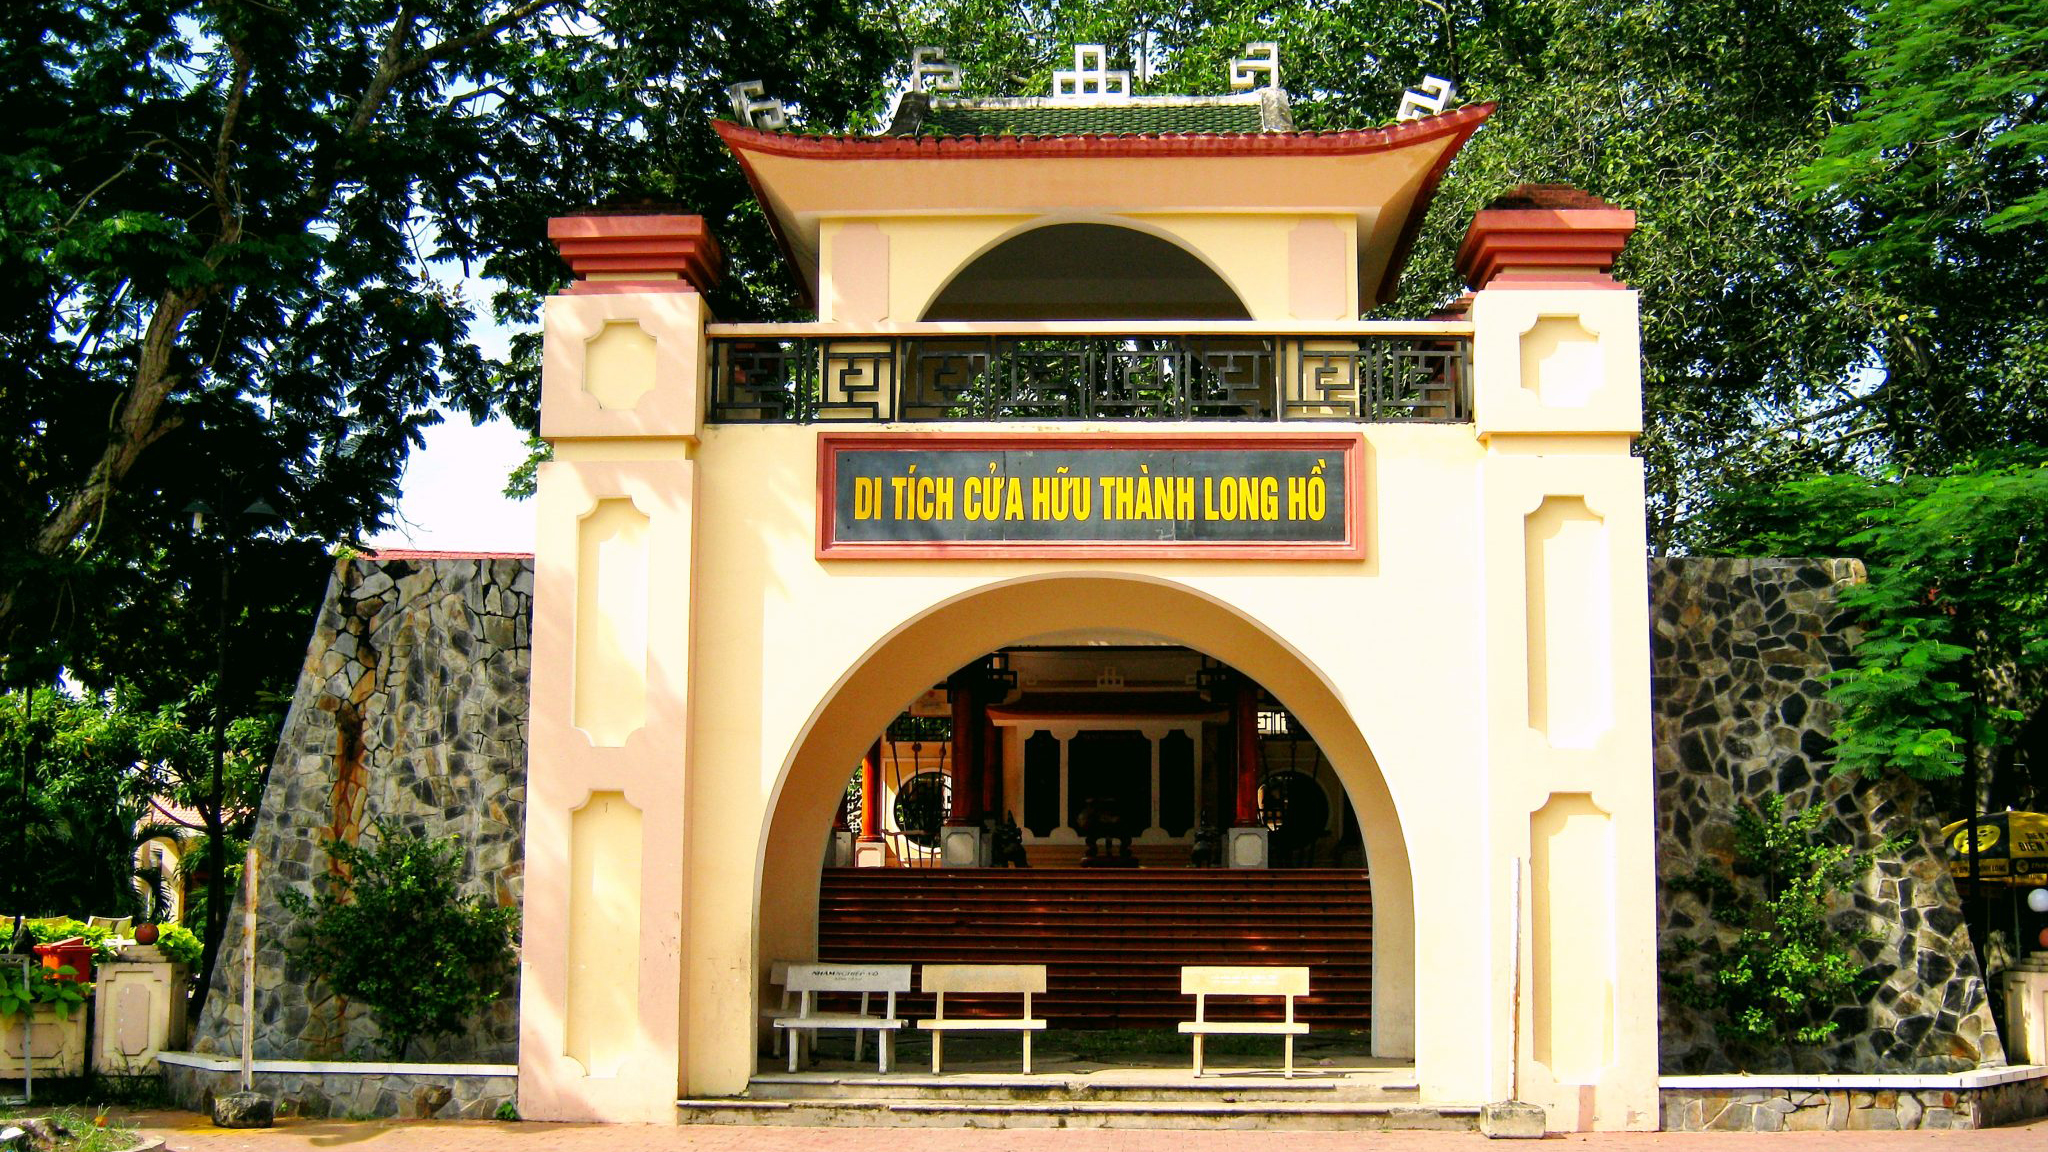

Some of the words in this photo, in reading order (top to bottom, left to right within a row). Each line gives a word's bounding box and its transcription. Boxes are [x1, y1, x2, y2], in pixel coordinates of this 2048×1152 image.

[854, 476, 883, 520] DI
[891, 464, 954, 521] TÍCH
[963, 461, 1025, 521] CỬA
[1032, 466, 1091, 521] HỮU
[1099, 464, 1195, 521] THÀNH
[1204, 476, 1279, 521] LONG
[1287, 458, 1327, 521] HỒ
